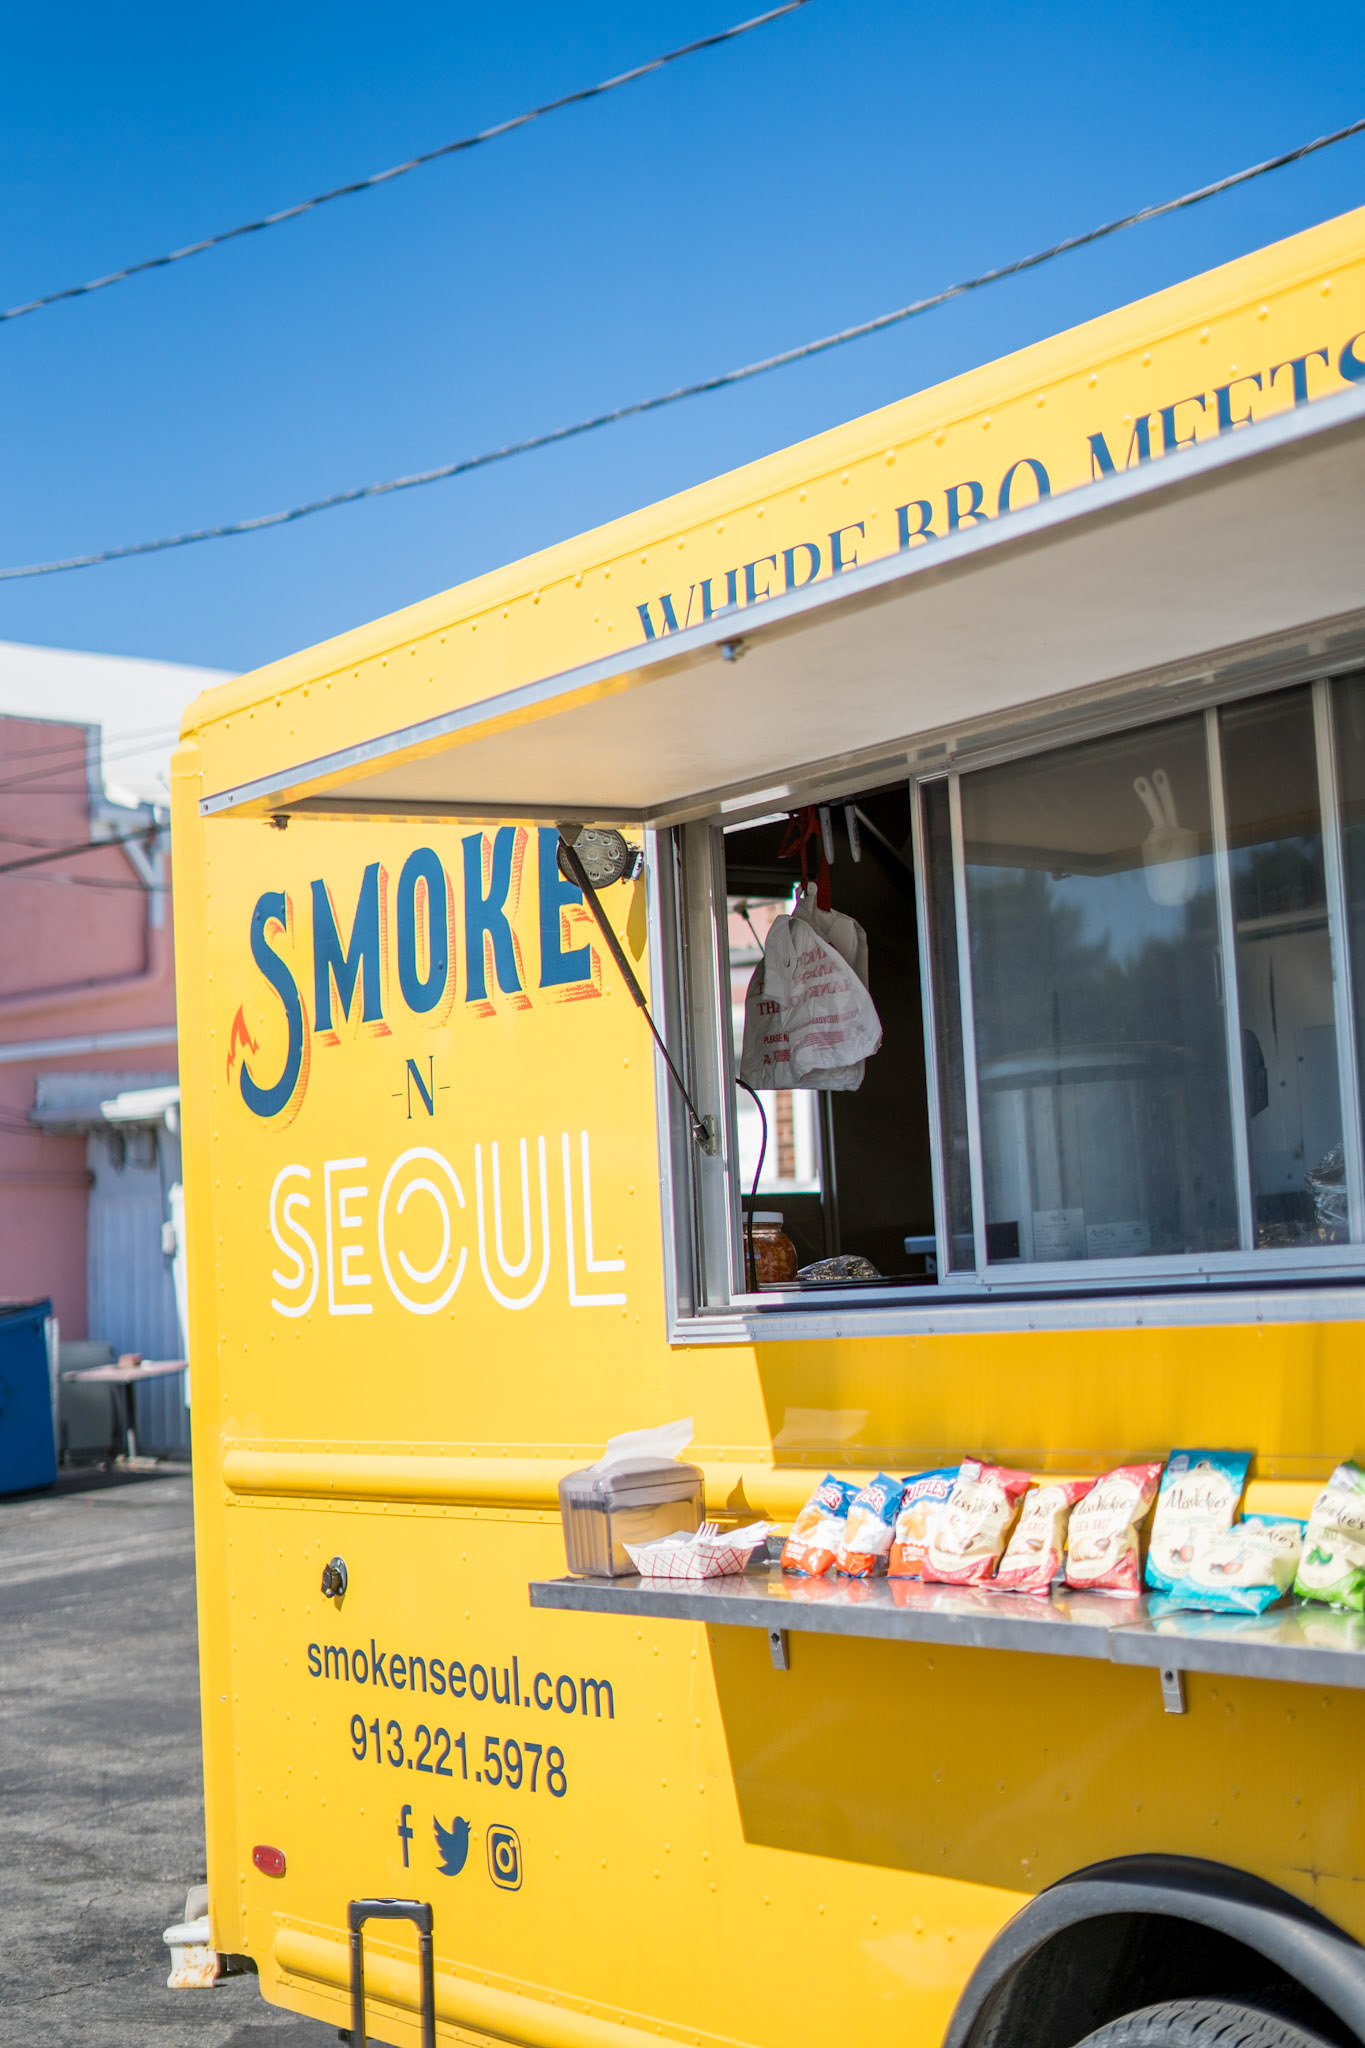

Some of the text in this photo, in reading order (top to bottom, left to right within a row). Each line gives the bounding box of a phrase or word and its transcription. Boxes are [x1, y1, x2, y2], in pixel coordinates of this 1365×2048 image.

[236, 826, 603, 1130] SMOKE
[268, 1130, 628, 1318] SEOUL
[307, 1638, 615, 1719] smokenseoul.com
[350, 1714, 568, 1798] 913.221.5978
